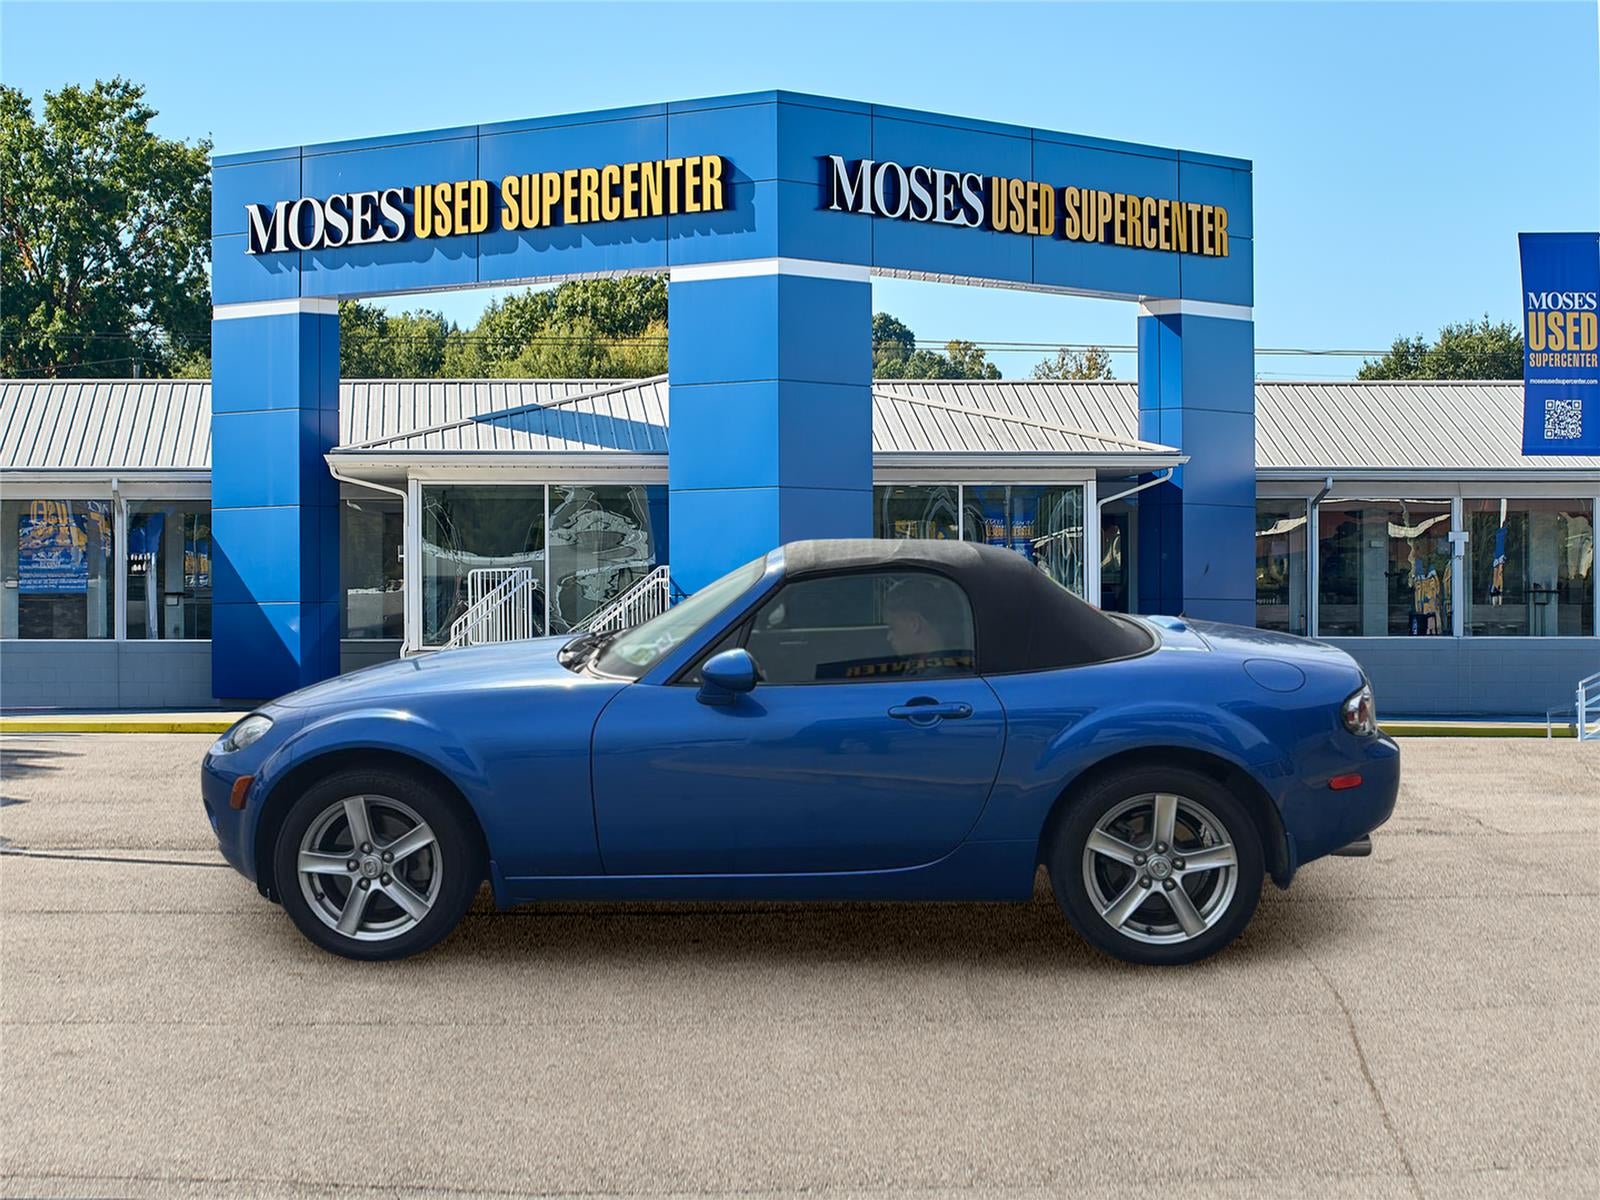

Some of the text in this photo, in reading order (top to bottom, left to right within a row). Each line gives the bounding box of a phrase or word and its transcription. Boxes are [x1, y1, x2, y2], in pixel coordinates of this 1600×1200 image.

[243, 154, 723, 256] MOSES USED SUPERCENTER
[828, 154, 1229, 257] MOSES USED SUPERCENTER
[1528, 292, 1597, 310] MOSES
[1527, 312, 1598, 351] USED
[1529, 353, 1598, 368] SUPERCENTER
